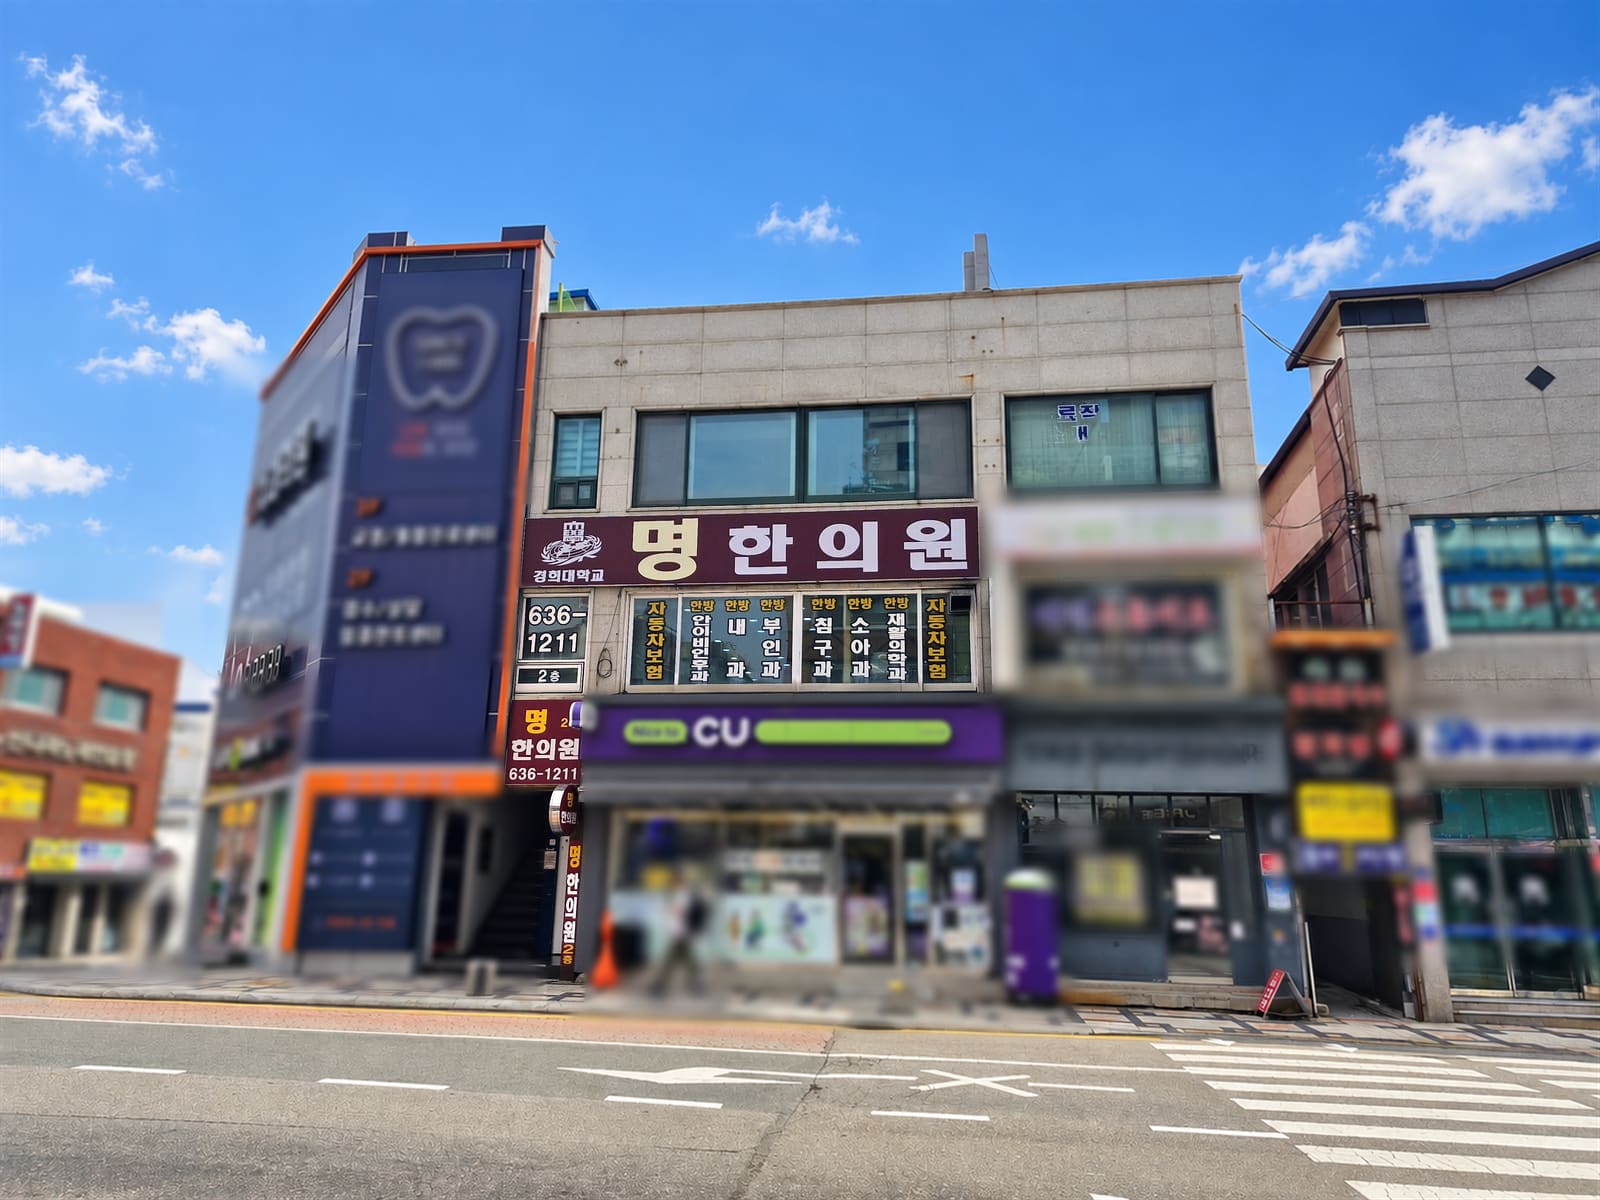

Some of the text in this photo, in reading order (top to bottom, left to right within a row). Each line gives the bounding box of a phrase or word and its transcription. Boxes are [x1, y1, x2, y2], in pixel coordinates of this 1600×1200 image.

[533, 569, 604, 583] 경희대학교
[690, 600, 715, 612] 한방
[725, 599, 750, 612] 한방
[760, 599, 785, 612] 한방
[811, 598, 836, 610] 한방
[848, 598, 872, 610] 한방
[884, 597, 909, 609] 한방
[528, 605, 587, 625] 636-
[528, 633, 578, 653] 1211
[690, 615, 712, 682] 안이비인후과
[761, 617, 781, 678] 부인과
[813, 617, 833, 678] 침구과
[851, 617, 871, 678] 소아과
[888, 613, 907, 680] 재활의학과
[525, 708, 548, 735] 명
[692, 715, 750, 747] CU
[511, 738, 580, 761] 한의원
[509, 767, 577, 780] 636-1211
